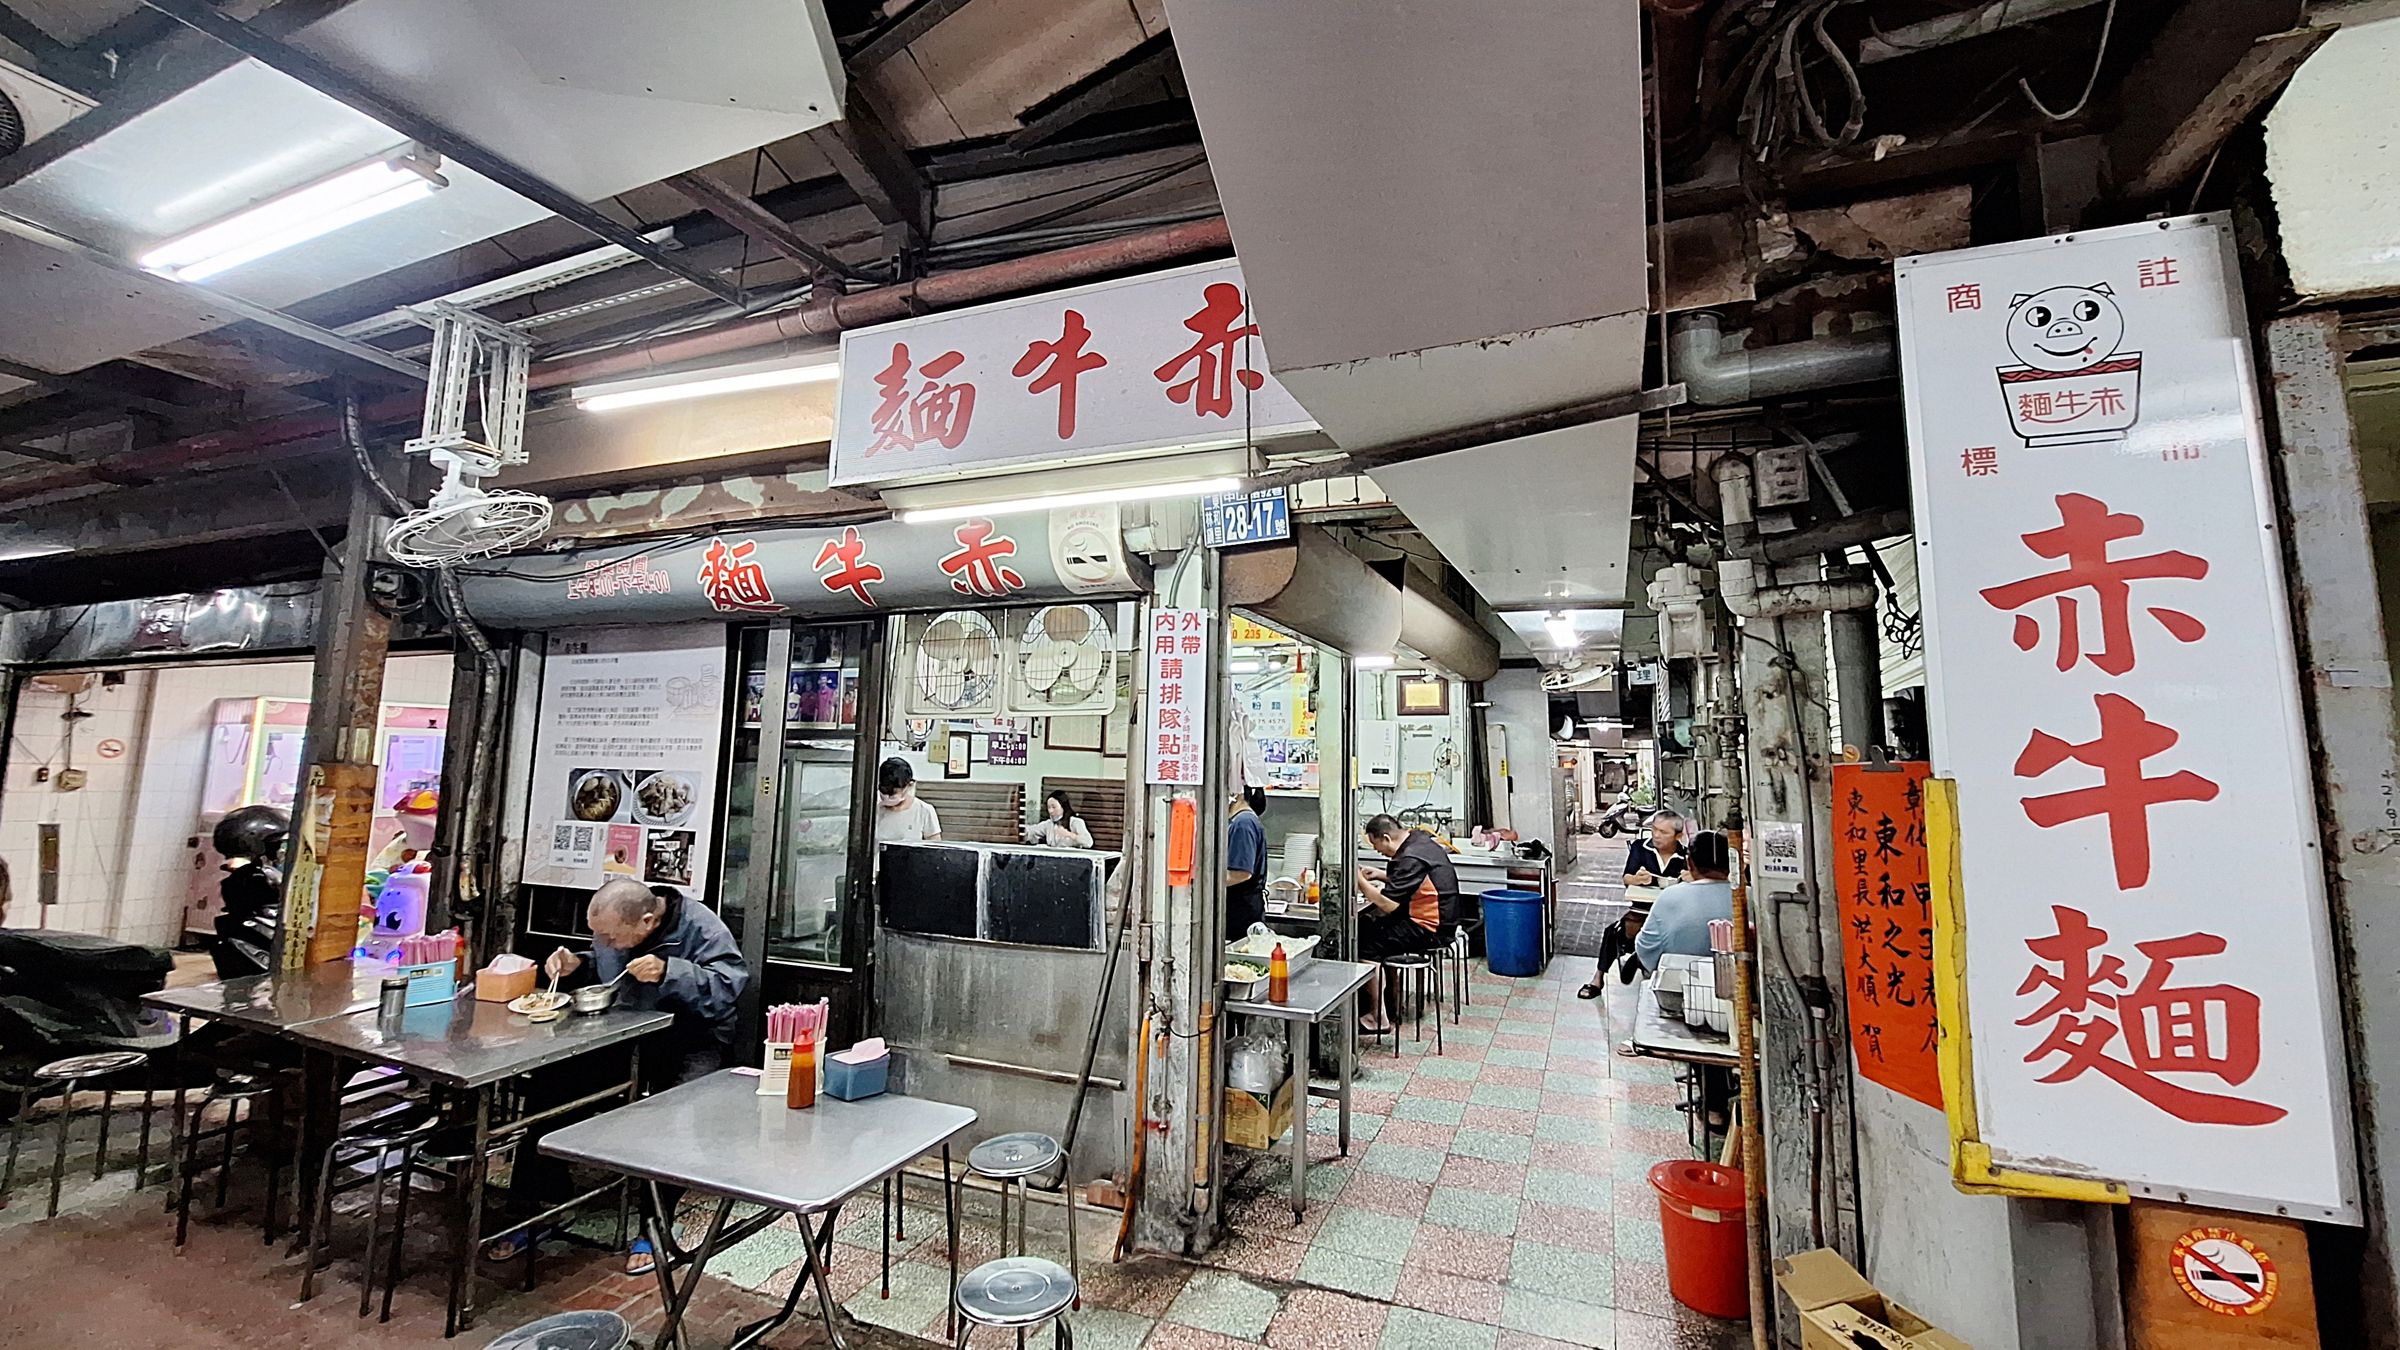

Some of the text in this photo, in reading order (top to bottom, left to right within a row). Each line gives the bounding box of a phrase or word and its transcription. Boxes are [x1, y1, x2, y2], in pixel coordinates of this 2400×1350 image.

[2137, 256, 2180, 289] 註
[1946, 282, 1983, 314] 商
[2017, 386, 2127, 424] 赤牛麵
[1960, 446, 1999, 477] 標
[697, 516, 1027, 613] 赤牛麵
[1155, 612, 1176, 655] 內用
[1181, 612, 1201, 655] 外帶
[1157, 658, 1184, 781] 請排隊點餐
[1977, 491, 2289, 1127] 赤牛麵
[1873, 812, 1916, 1008] 東和之光
